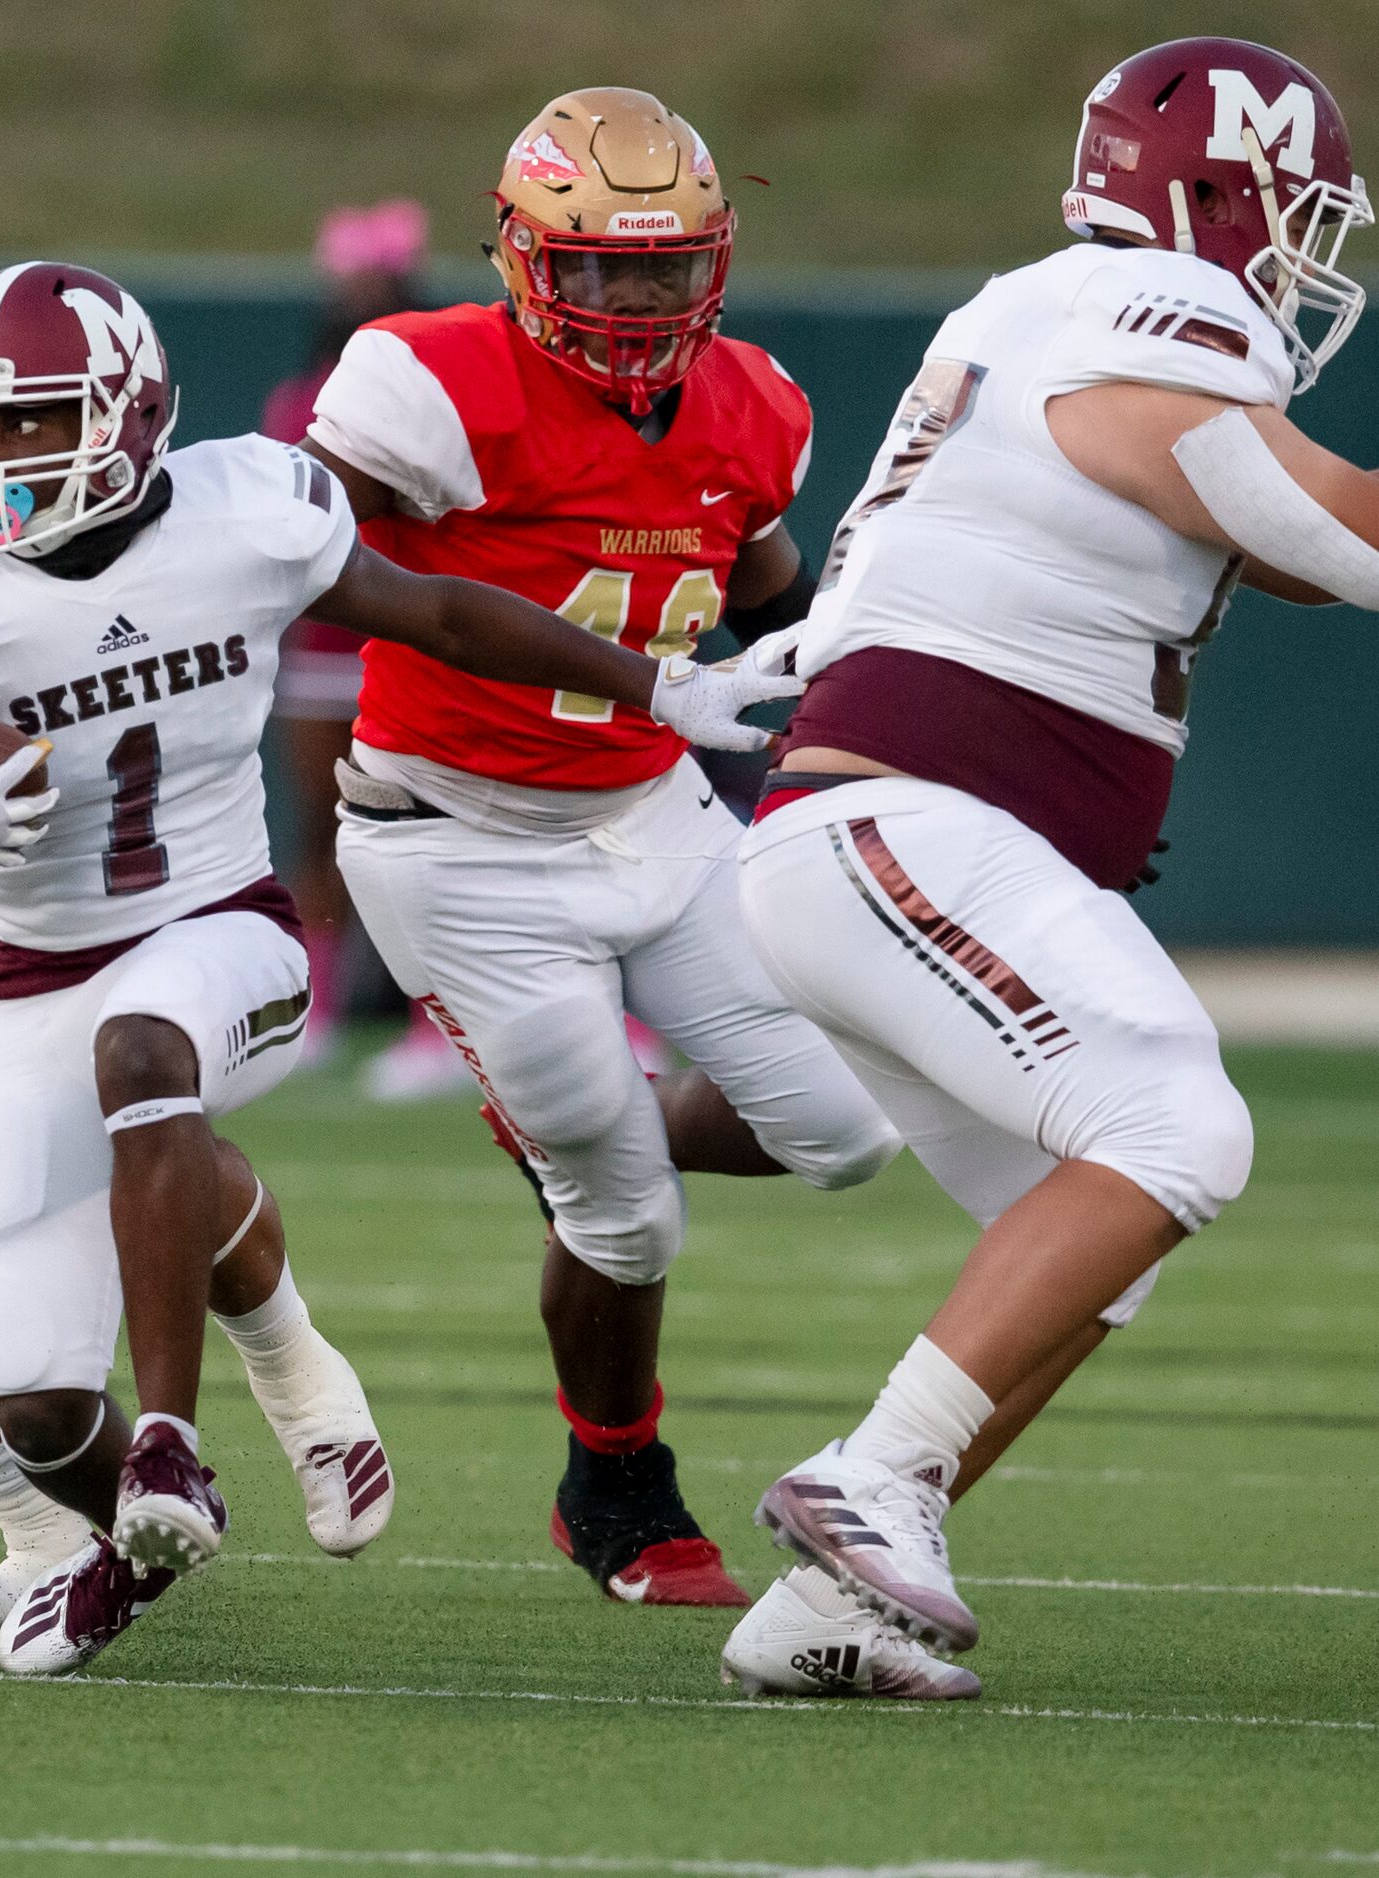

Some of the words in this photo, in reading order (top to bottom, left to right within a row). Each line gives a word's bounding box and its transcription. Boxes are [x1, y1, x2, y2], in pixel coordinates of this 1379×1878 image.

[1206, 69, 1316, 179] M
[618, 217, 675, 229] Riddell
[60, 287, 163, 383] M
[599, 527, 703, 554] WARRIORS
[9, 633, 249, 737] SKEETERS
[96, 632, 150, 655] adidas
[101, 721, 170, 897] 1
